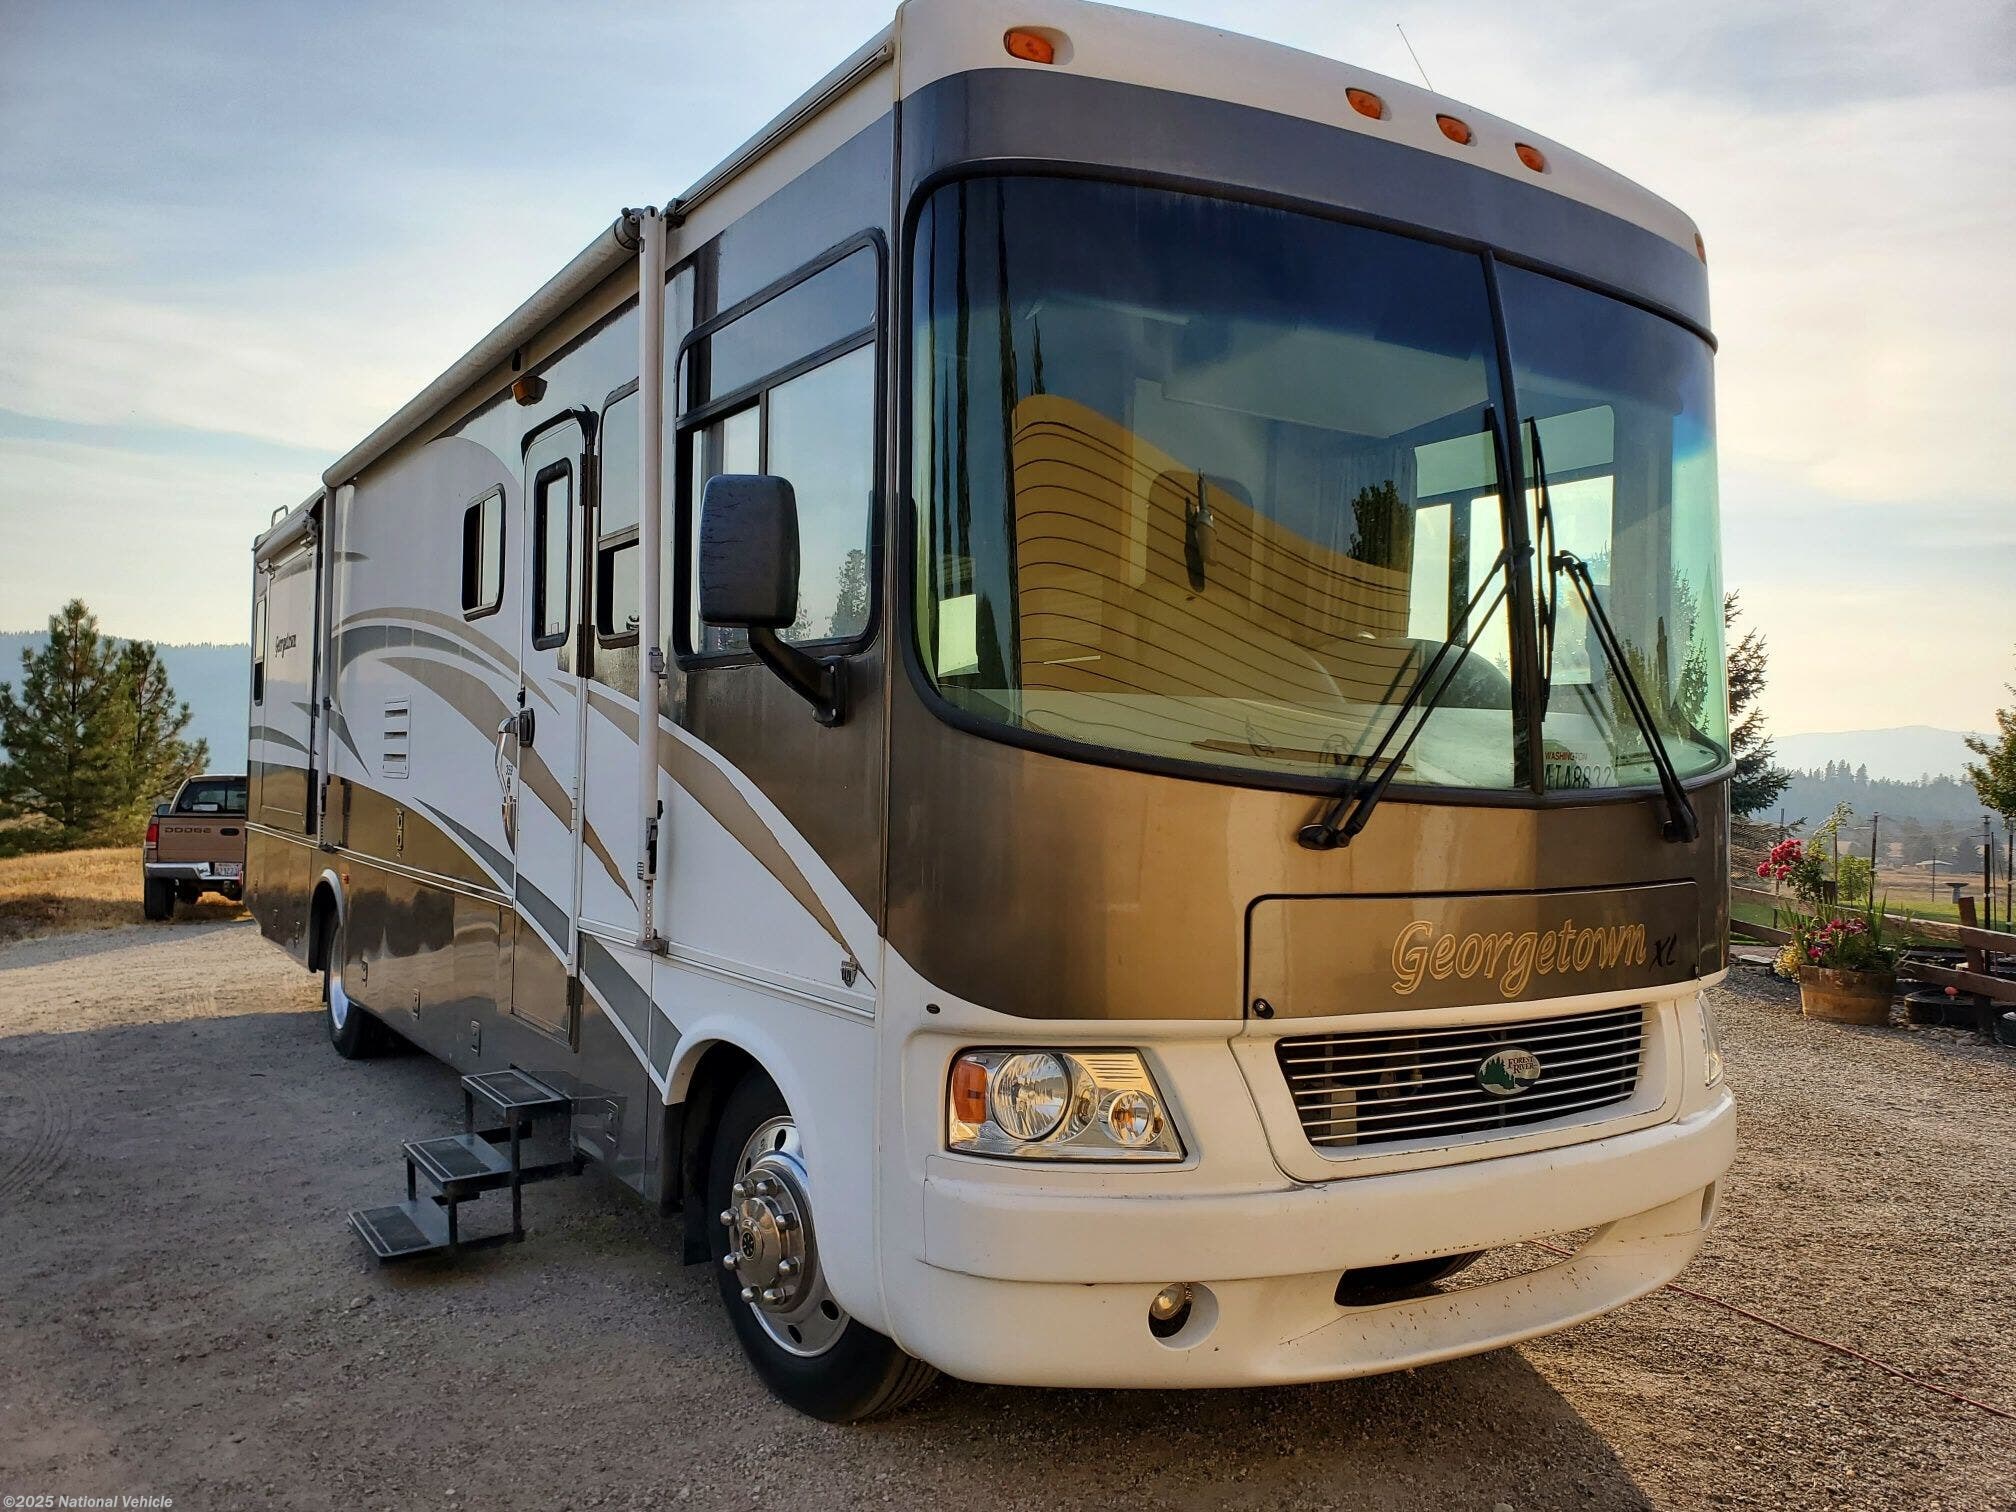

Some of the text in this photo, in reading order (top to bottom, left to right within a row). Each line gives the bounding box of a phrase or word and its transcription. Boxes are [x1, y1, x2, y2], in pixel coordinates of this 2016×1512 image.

[1391, 918, 1647, 998] Georgetown
[1508, 1056, 1534, 1069] FOREST
[1513, 1063, 1535, 1074] RIVER
